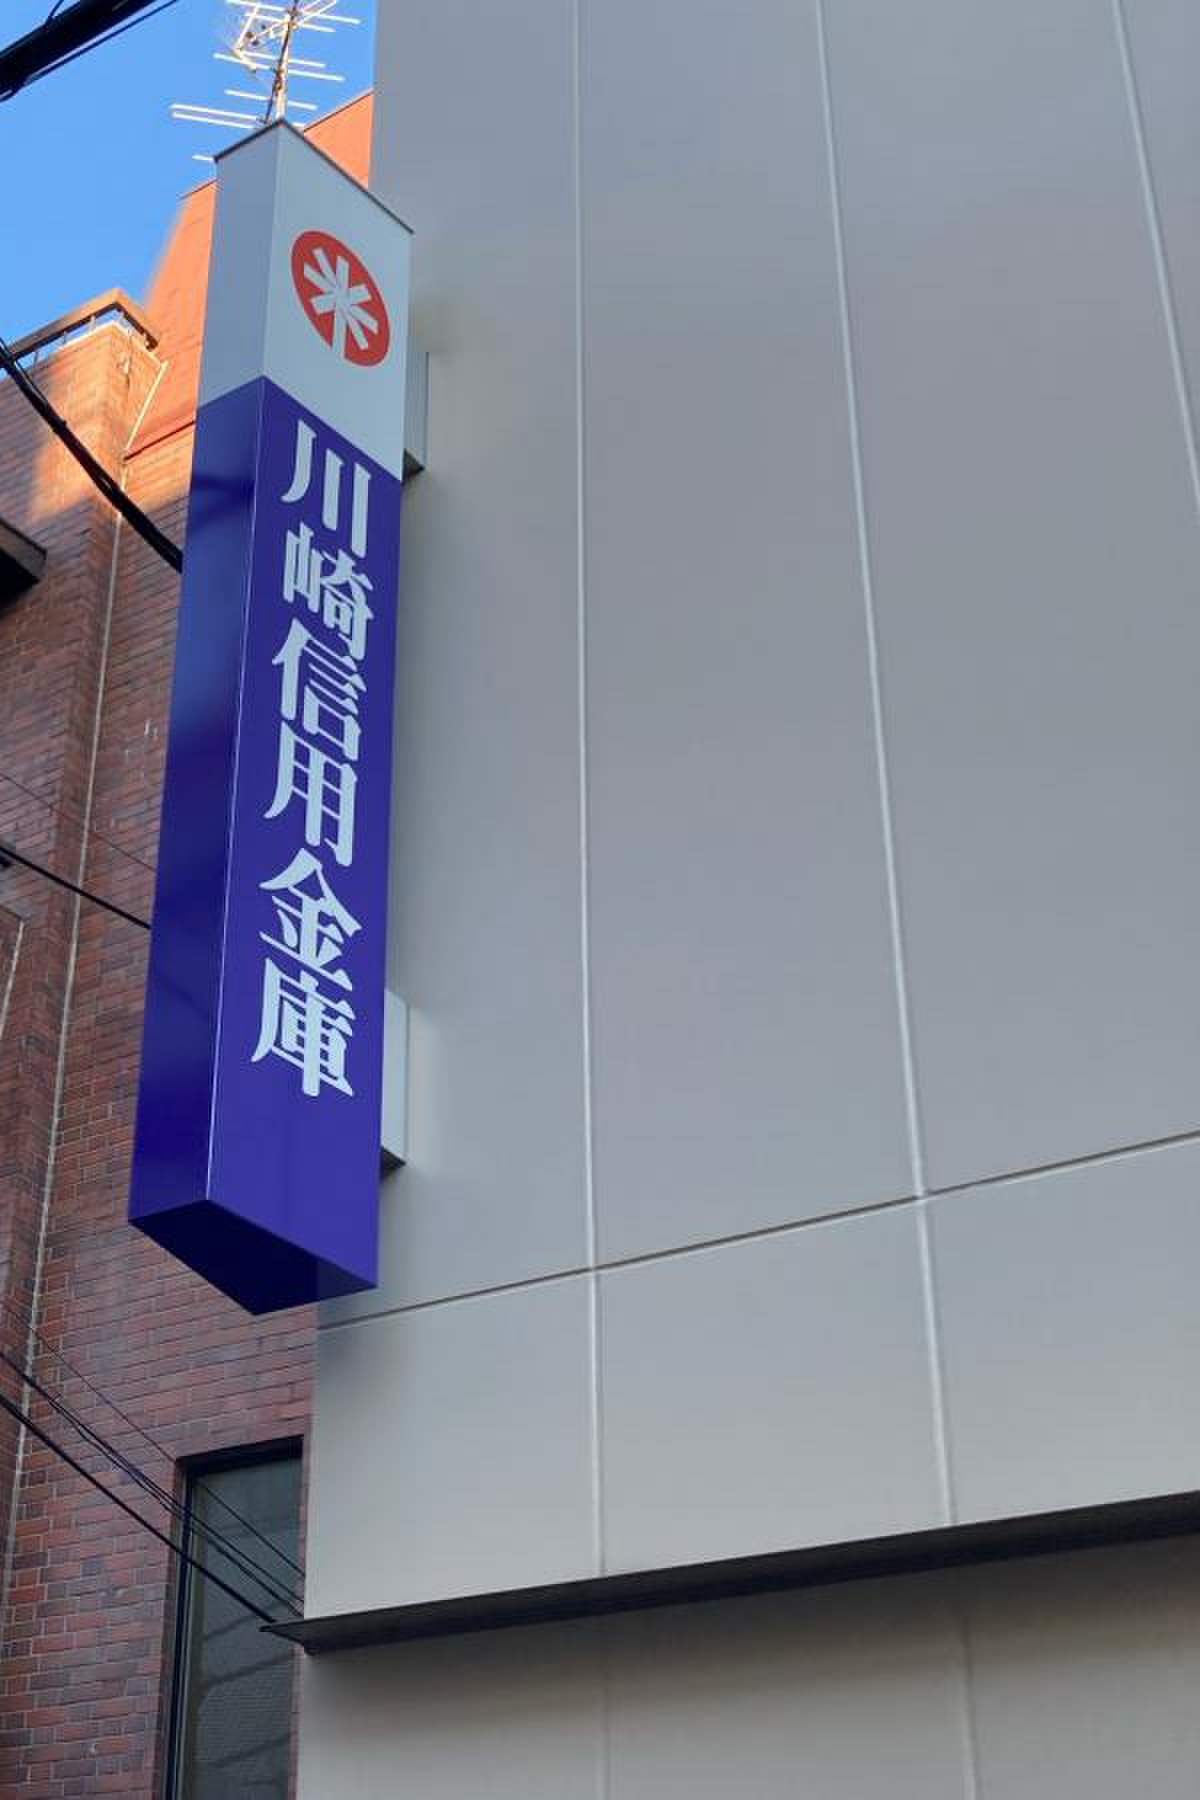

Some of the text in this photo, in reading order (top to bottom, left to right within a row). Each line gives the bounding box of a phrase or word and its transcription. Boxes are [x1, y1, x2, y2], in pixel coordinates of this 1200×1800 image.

[251, 420, 374, 1097] 川崎信用金庫
